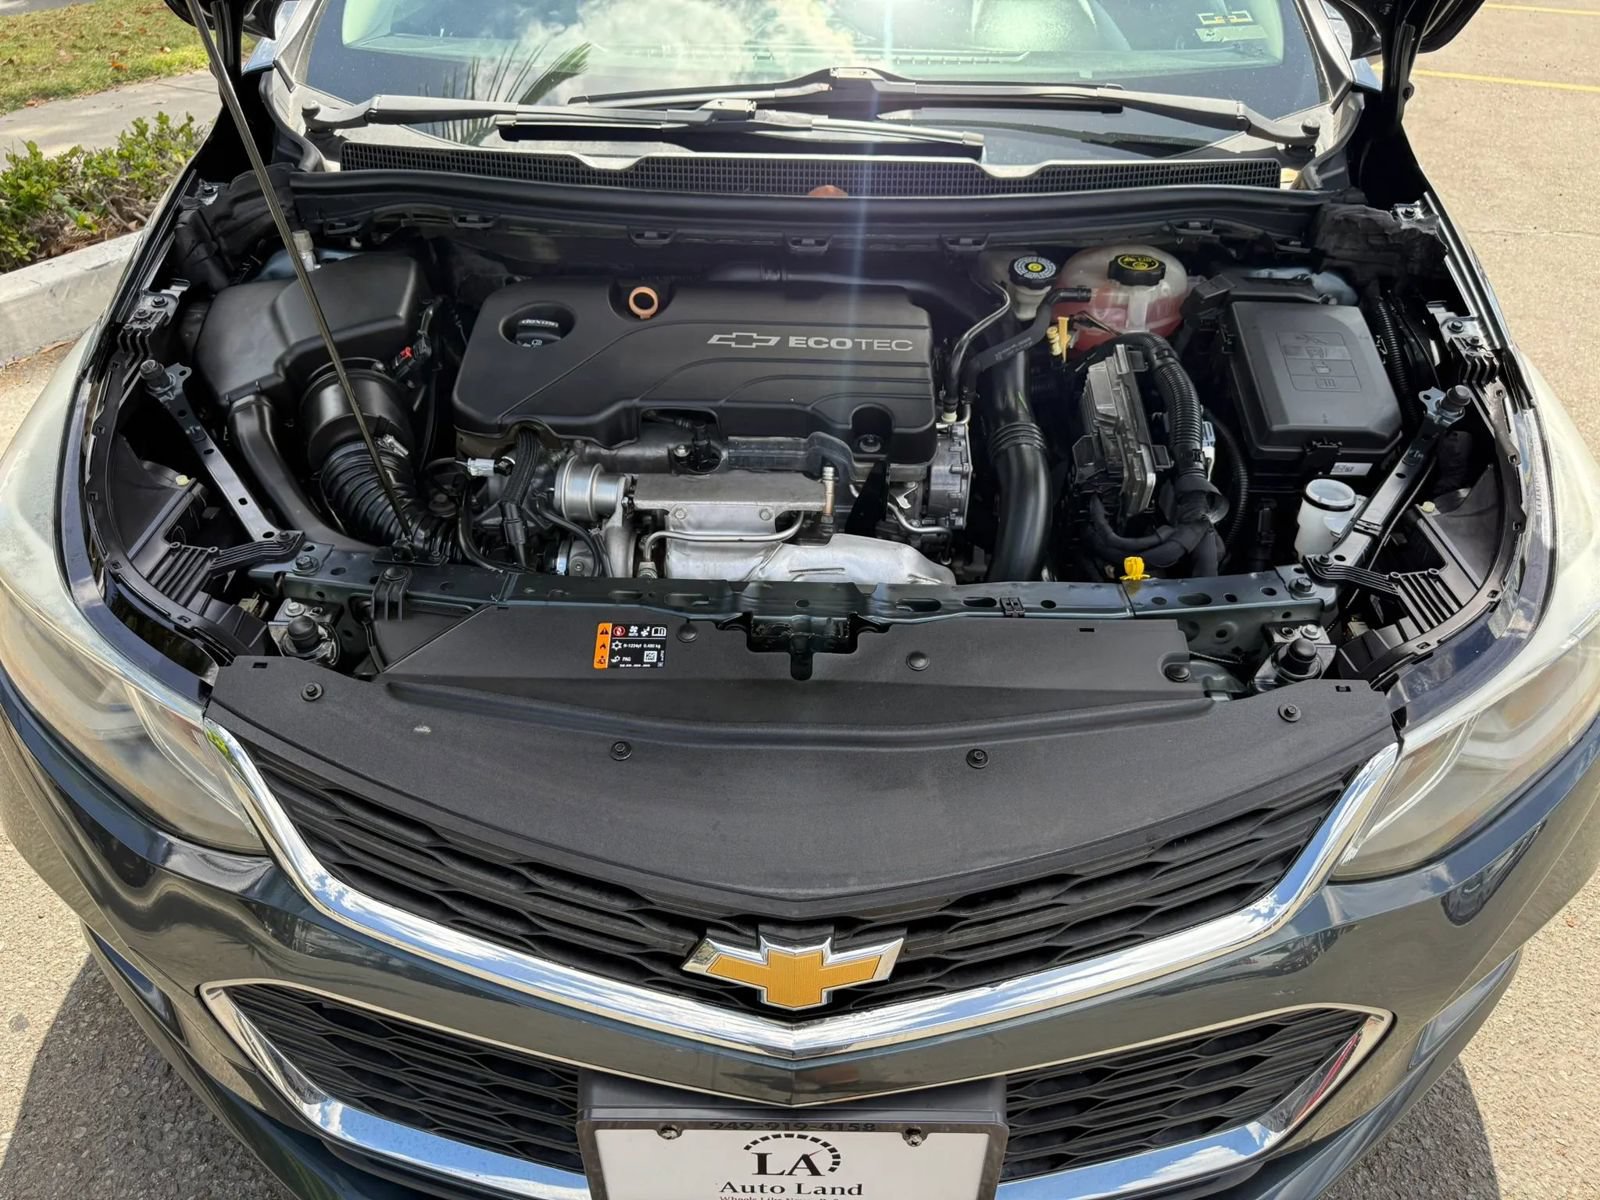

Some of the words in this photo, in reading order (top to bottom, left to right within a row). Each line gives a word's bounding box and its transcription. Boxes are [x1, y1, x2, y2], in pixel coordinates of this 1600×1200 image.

[788, 336, 913, 351] ECOTEC
[709, 1121, 876, 1132] 949-919-4158
[752, 1152, 825, 1176] LA
[720, 1181, 785, 1194] Auto
[796, 1183, 864, 1195] Land
